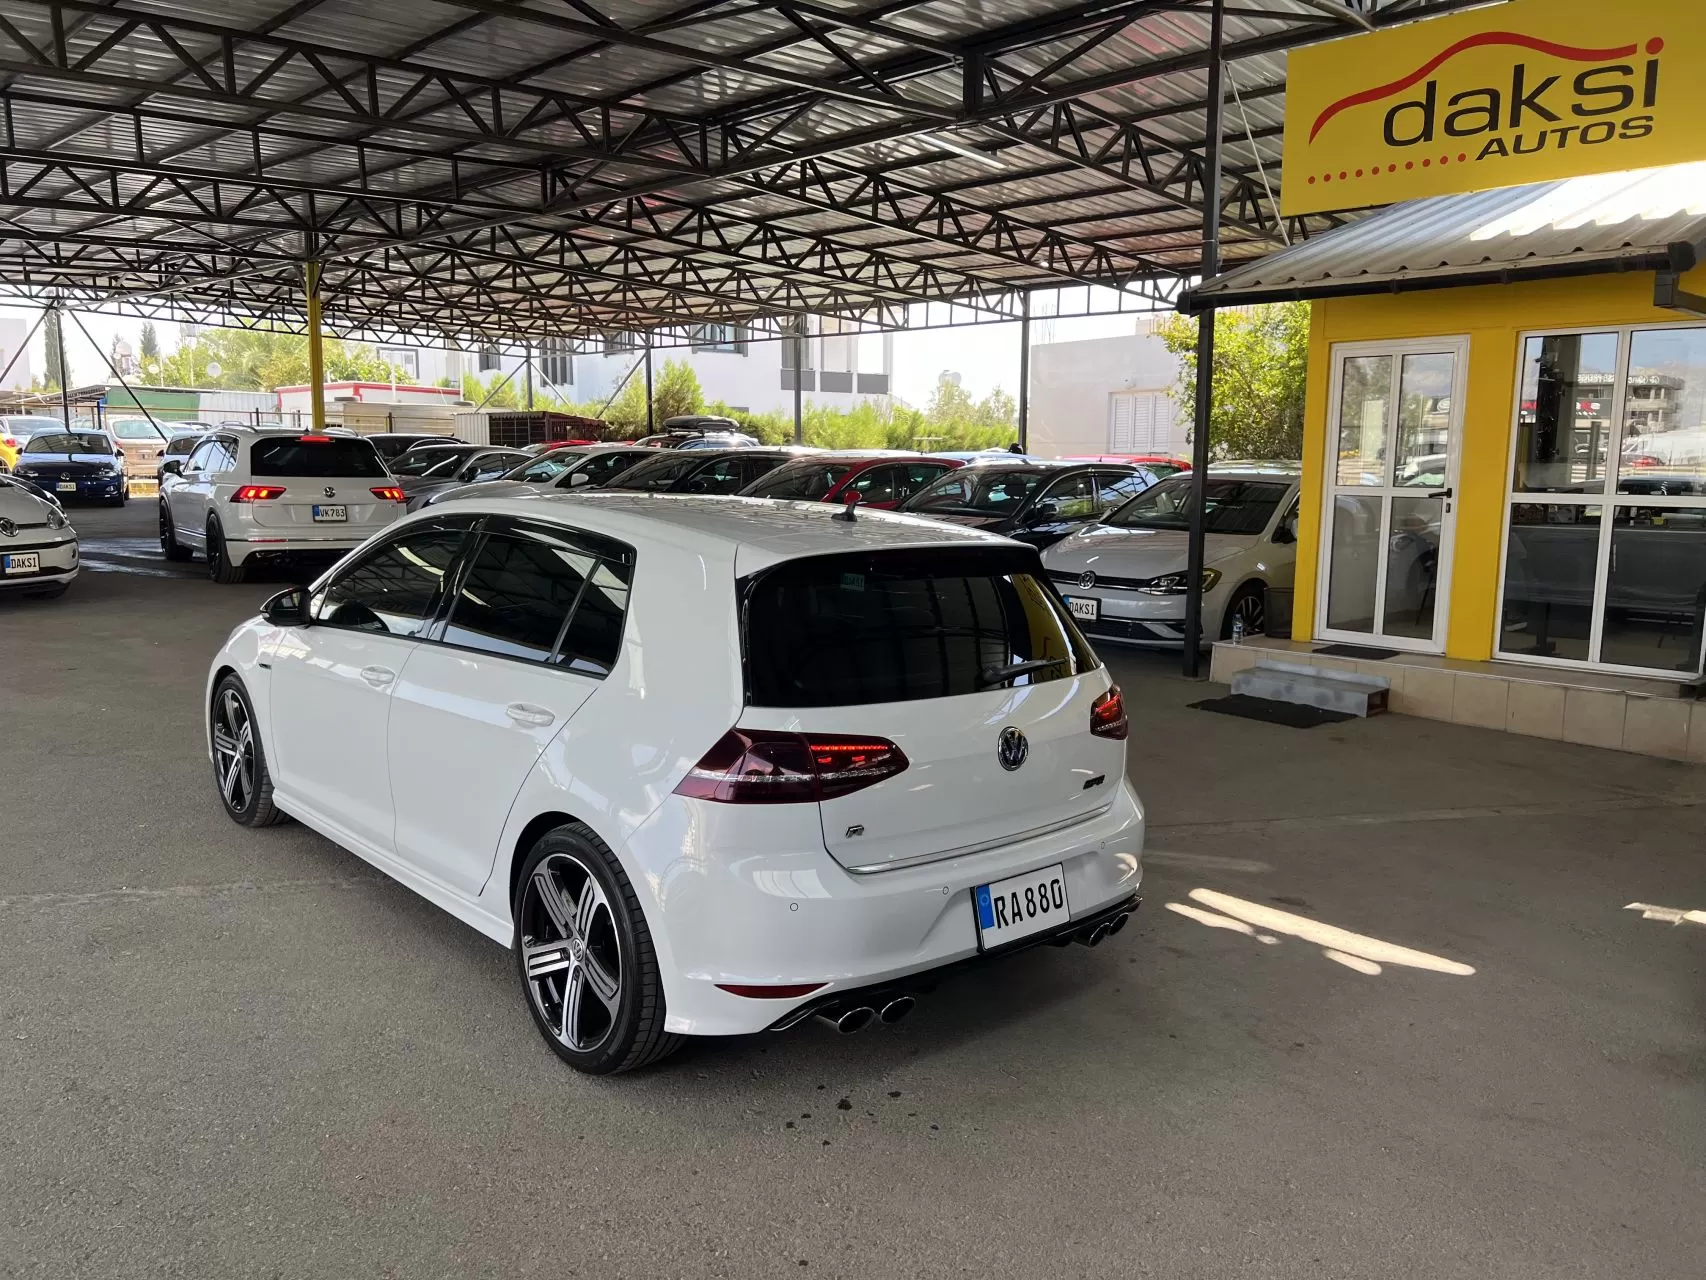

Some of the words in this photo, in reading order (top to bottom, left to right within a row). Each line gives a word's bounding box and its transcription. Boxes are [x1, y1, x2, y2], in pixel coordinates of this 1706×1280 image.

[1383, 37, 1664, 147] daksi
[1475, 115, 1655, 161] AUTOS
[320, 508, 345, 517] VK783
[11, 557, 37, 569] DAKSI
[994, 879, 1064, 929] RA880
